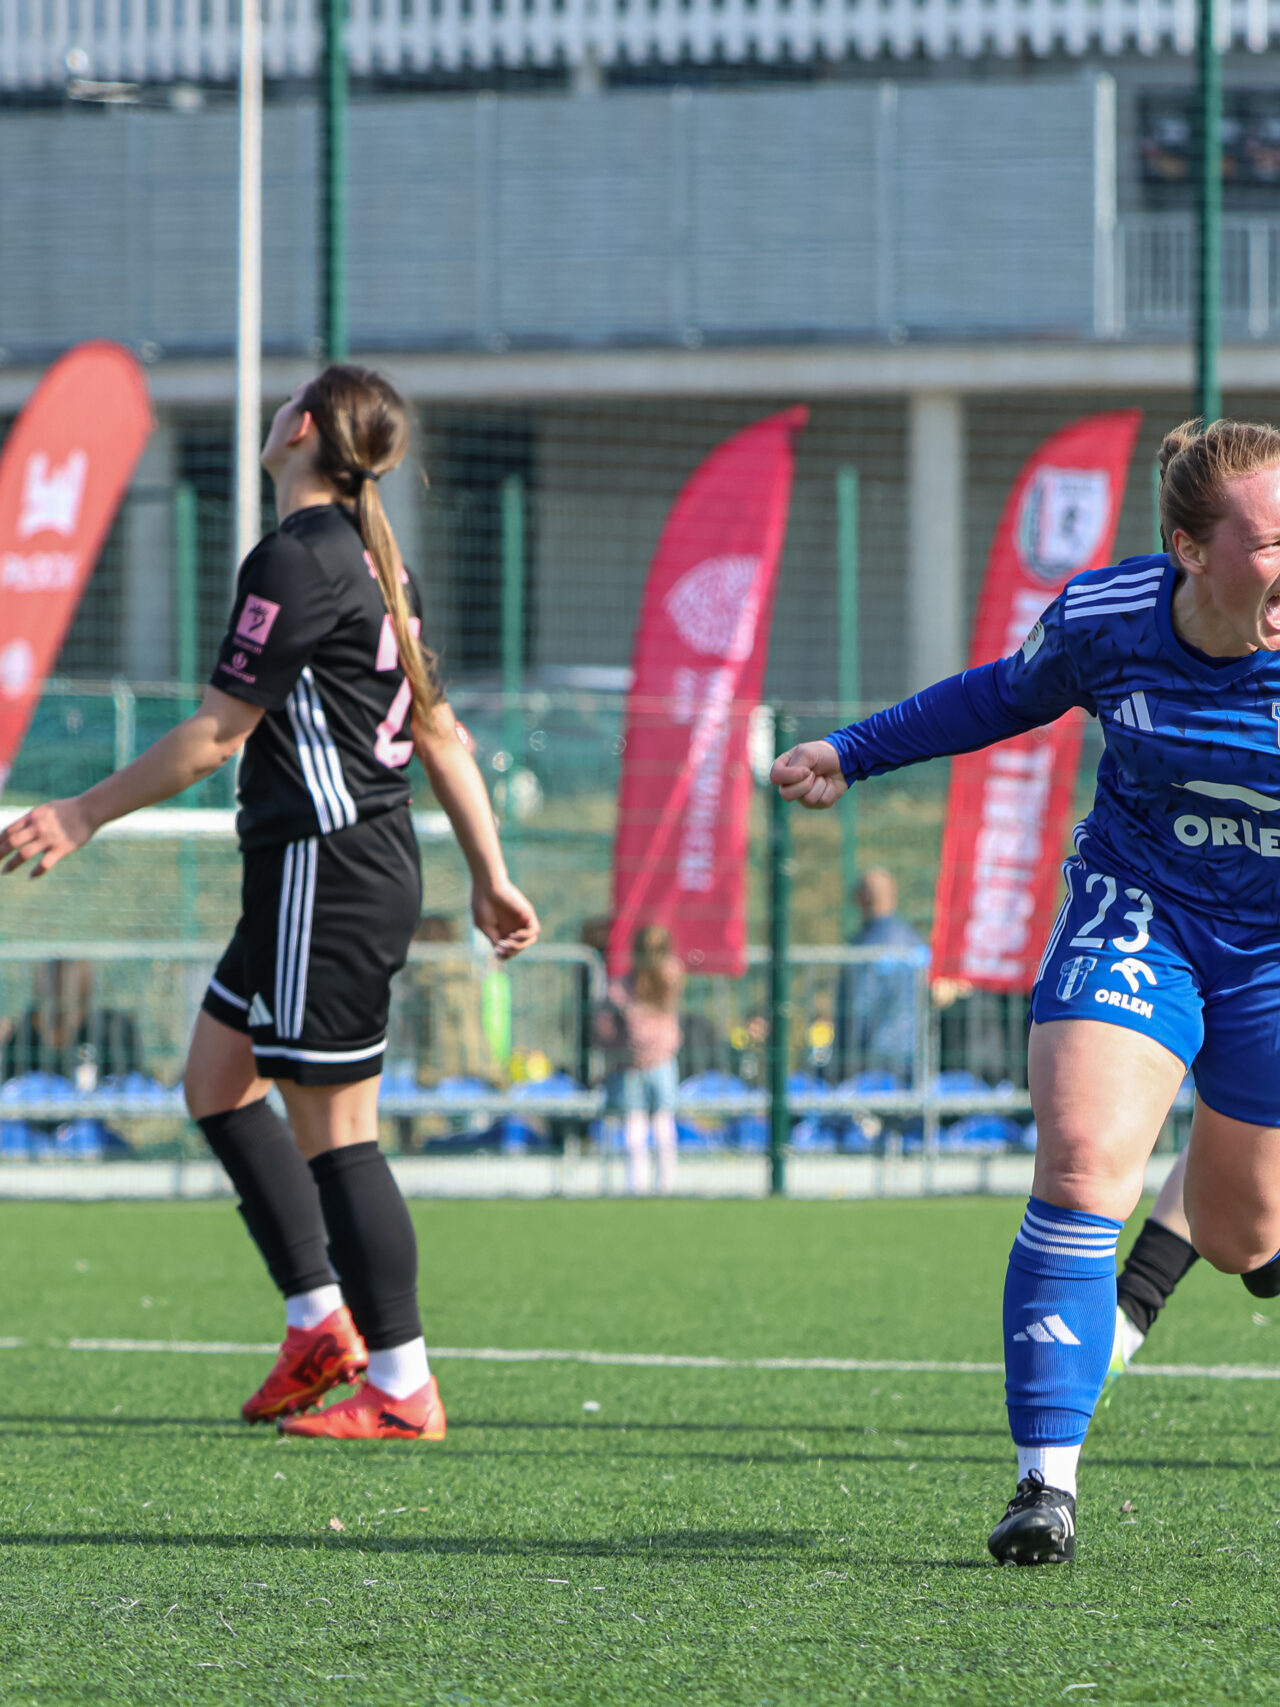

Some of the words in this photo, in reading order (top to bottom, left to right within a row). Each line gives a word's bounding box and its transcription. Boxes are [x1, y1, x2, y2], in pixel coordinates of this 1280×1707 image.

[960, 742, 1057, 981] FOOTBALL
[1069, 873, 1155, 954] 23
[1094, 988, 1155, 1019] ORLEN
